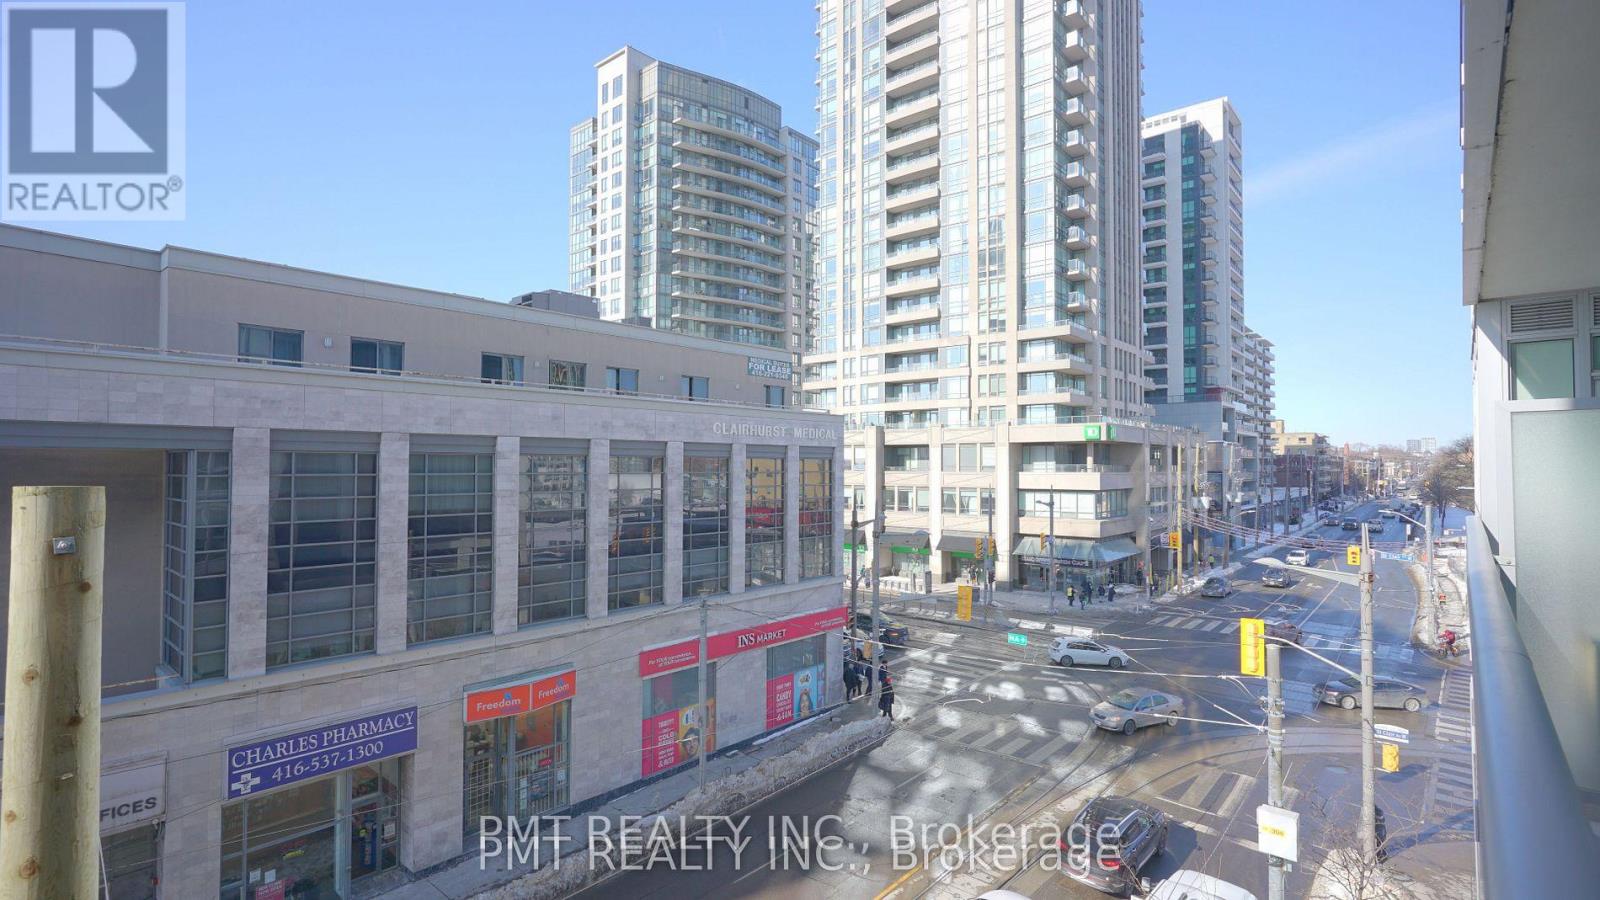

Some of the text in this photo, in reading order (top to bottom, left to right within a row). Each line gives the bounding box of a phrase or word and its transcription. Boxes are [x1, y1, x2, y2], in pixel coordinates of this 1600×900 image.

[749, 362, 765, 371] FOR
[767, 365, 791, 375] LEASE
[713, 422, 838, 440] CLAIRHURST MEDICAL
[737, 629, 787, 648] INS MARKET
[477, 698, 521, 712] Freedom
[538, 682, 570, 699] Freedom
[232, 711, 415, 768] CHARLES PHARMACY
[272, 741, 384, 782] 416-537-1300
